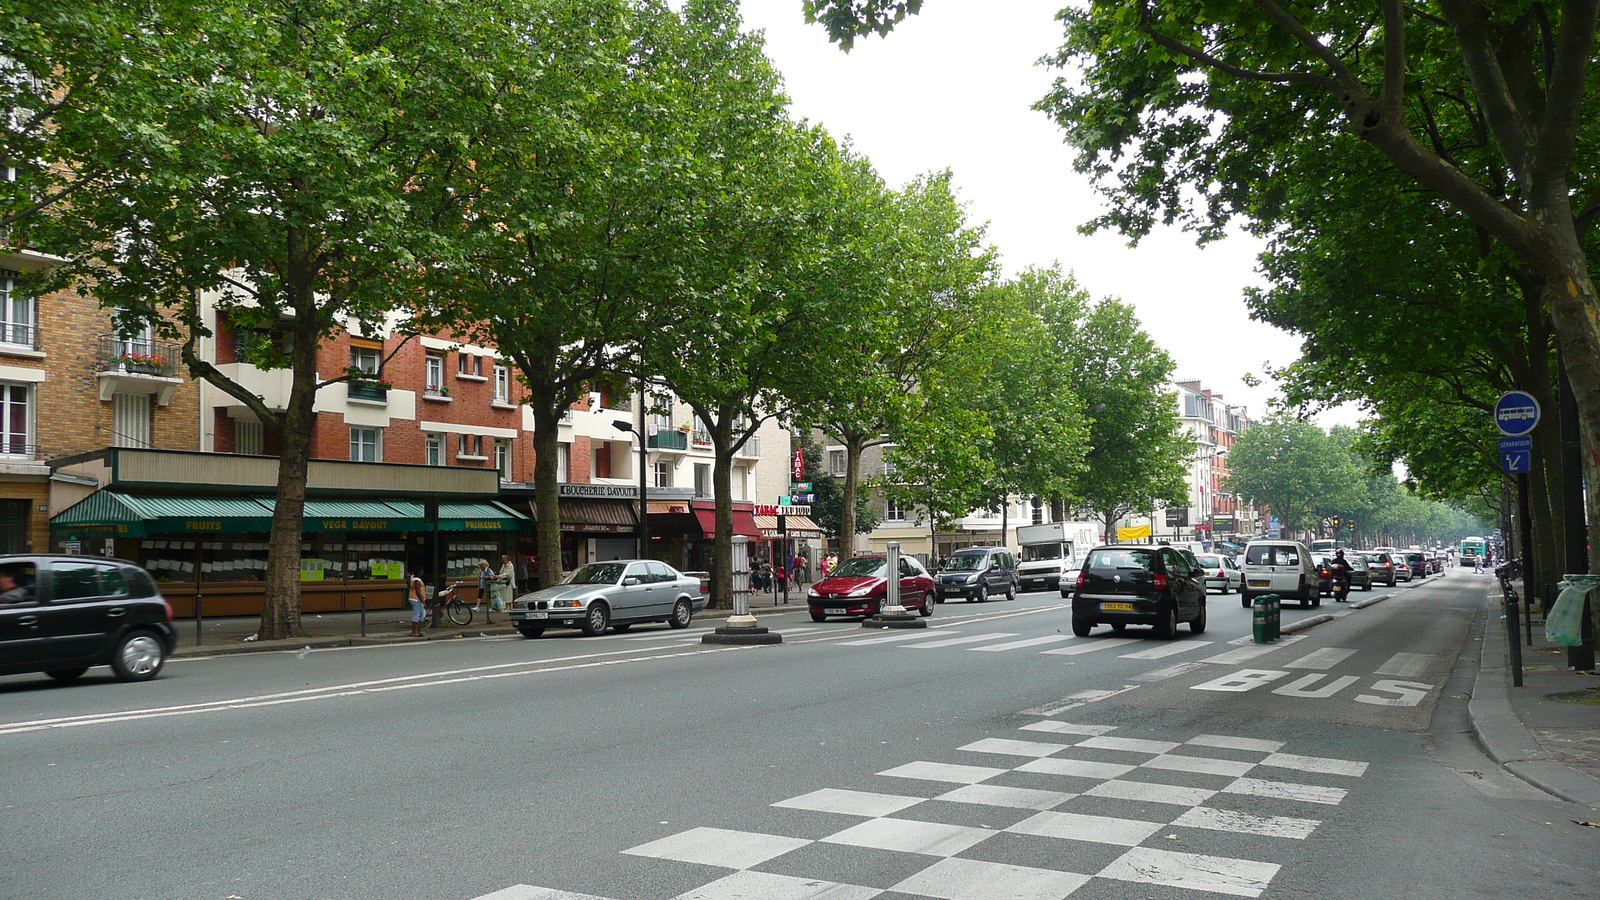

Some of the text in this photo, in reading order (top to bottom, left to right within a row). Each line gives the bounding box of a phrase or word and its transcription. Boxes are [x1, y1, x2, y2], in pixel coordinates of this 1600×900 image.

[566, 485, 633, 497] BOUCHERIE DAVOUT
[754, 504, 779, 515] TABAC
[186, 521, 221, 530] FRUITS
[322, 520, 388, 529] VEGE DAVOUT
[465, 521, 502, 529] PRIMEURS
[1079, 529, 1093, 545] BCT
[1190, 668, 1435, 707] BUS
